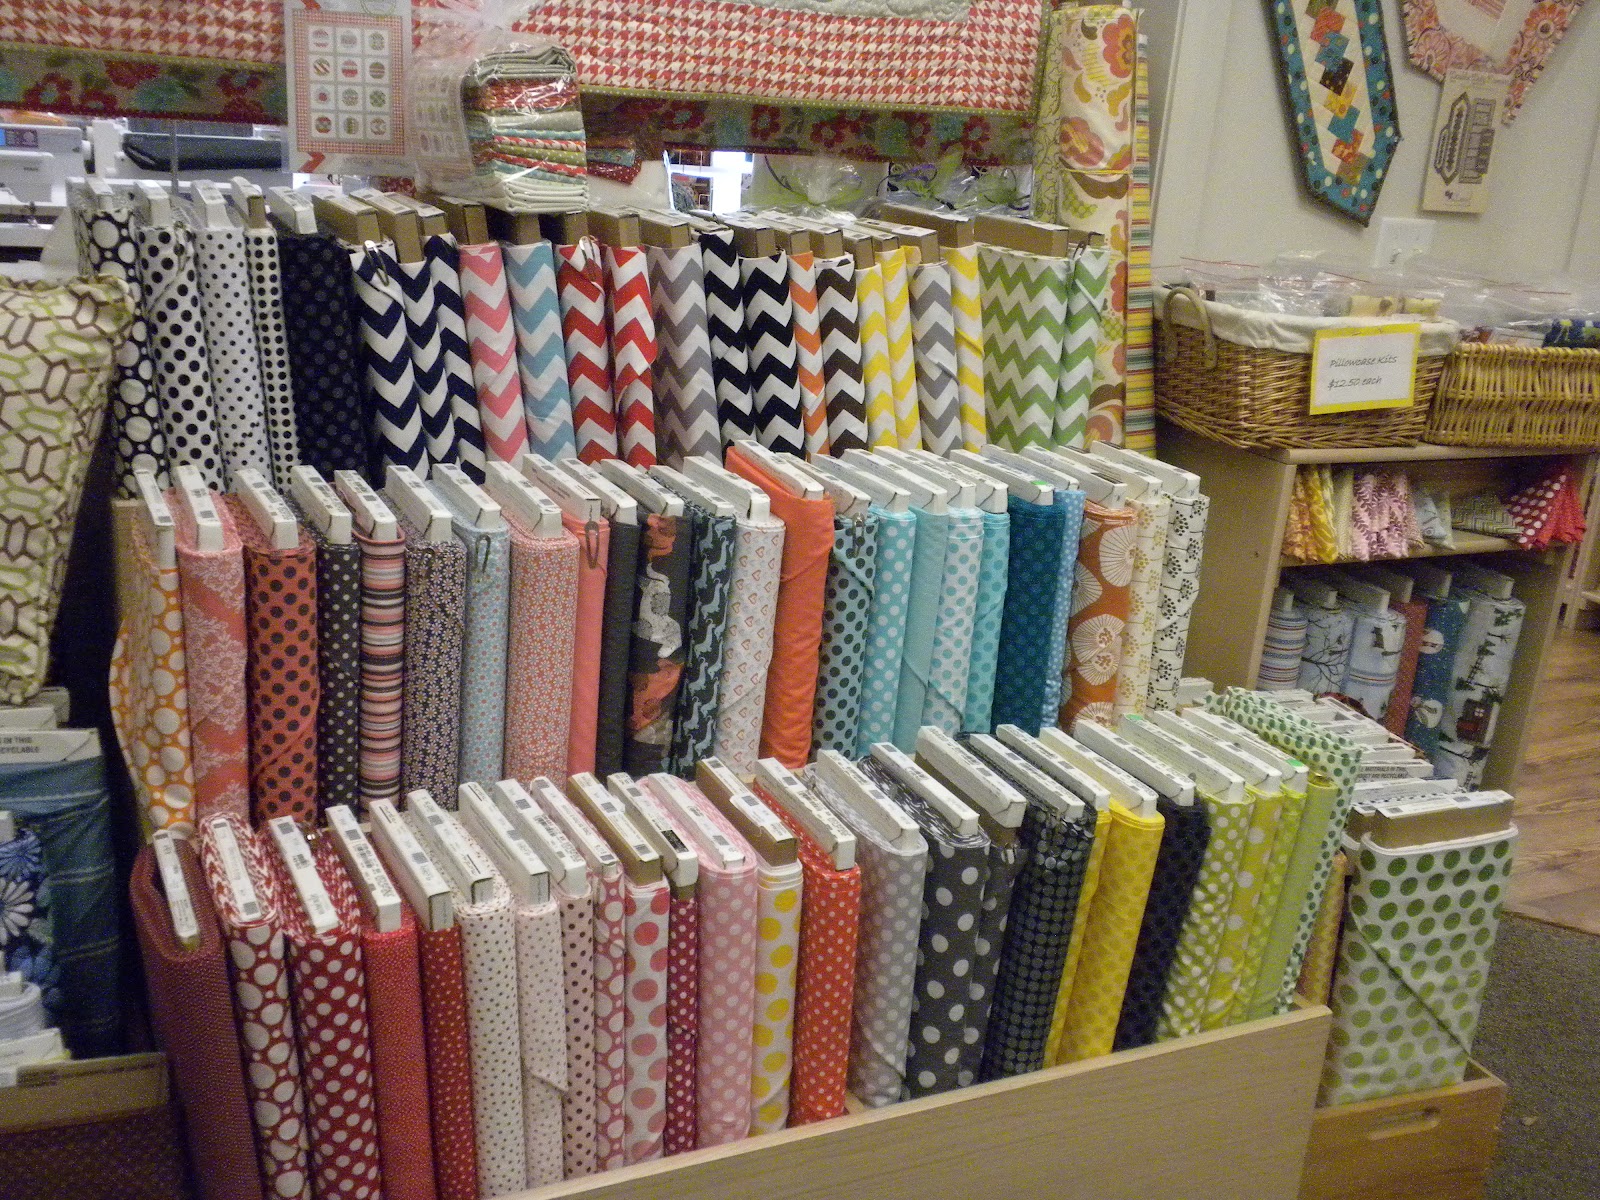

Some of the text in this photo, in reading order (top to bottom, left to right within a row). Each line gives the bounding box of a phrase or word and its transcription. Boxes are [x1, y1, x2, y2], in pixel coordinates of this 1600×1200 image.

[1377, 354, 1398, 364] Kits
[1327, 376, 1382, 391] $12.50 each
